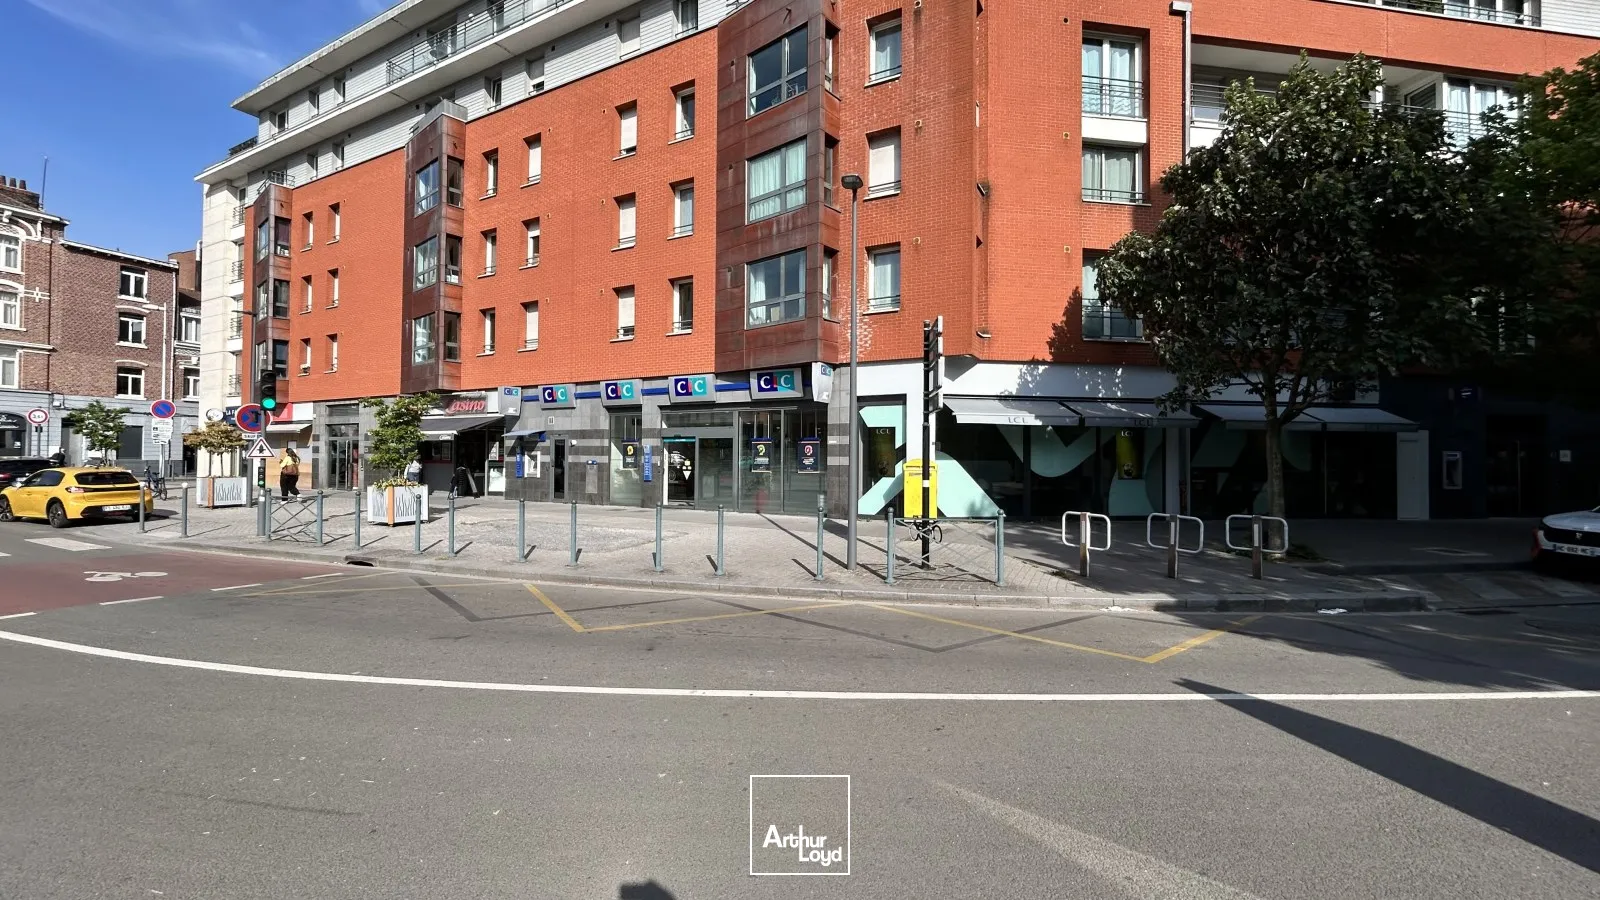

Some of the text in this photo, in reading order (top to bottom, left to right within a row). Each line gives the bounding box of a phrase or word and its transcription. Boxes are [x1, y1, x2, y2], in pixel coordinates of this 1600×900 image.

[676, 380, 704, 394] CIC
[760, 374, 791, 389] CIC
[544, 388, 566, 400] CIC
[607, 384, 632, 397] CIC
[1008, 416, 1029, 424] LCL
